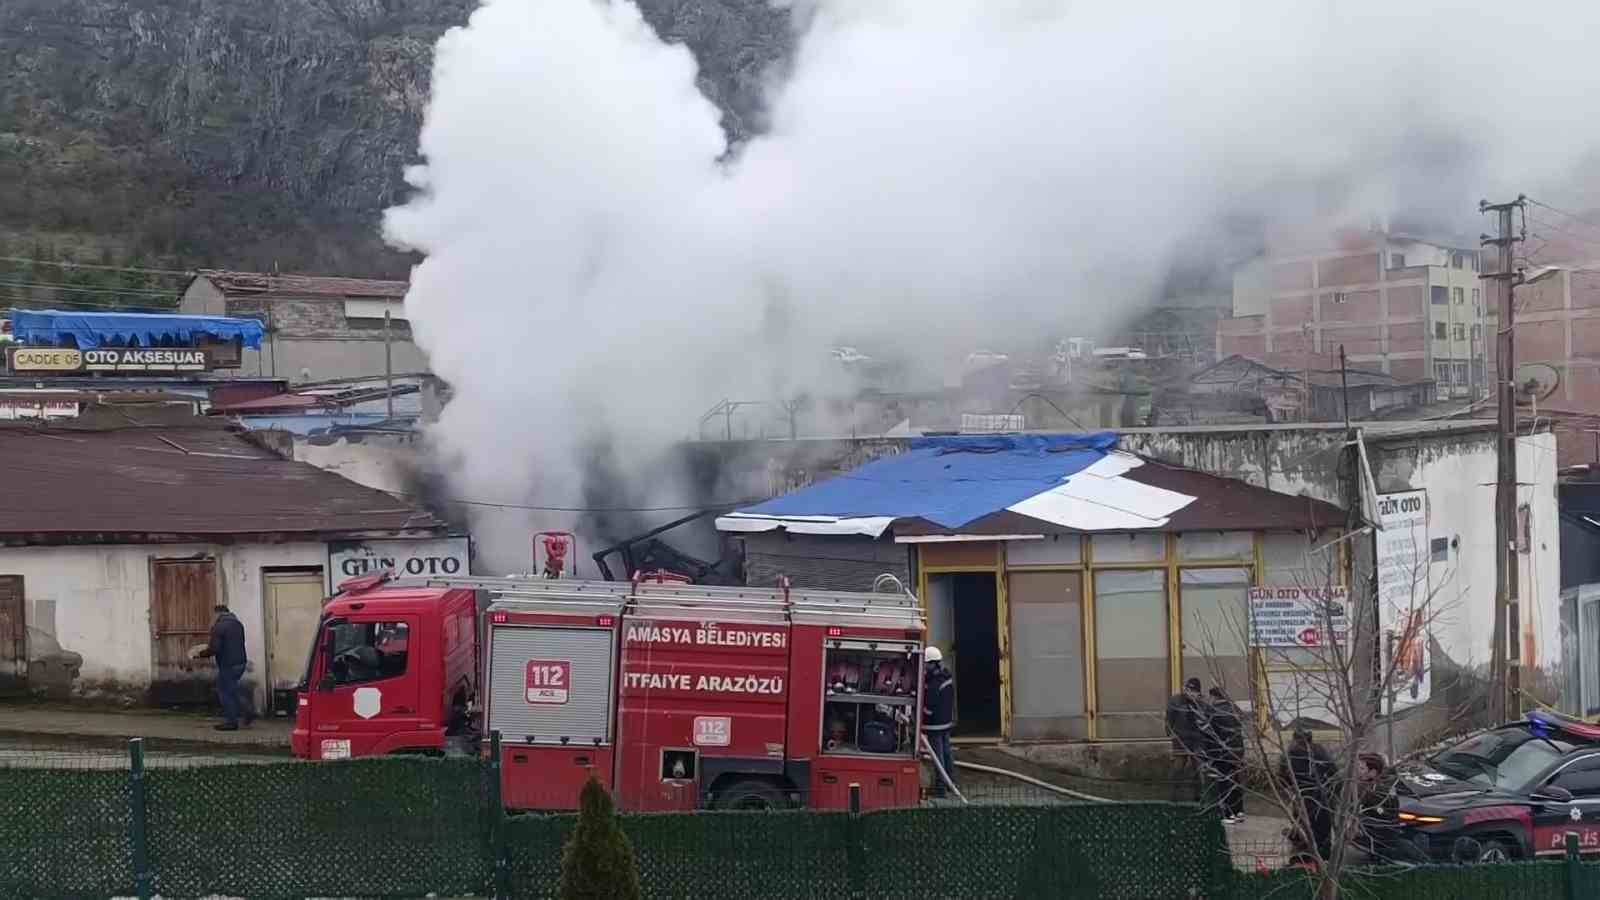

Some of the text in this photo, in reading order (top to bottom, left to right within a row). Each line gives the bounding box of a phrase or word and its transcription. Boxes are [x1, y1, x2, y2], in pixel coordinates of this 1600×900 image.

[17, 353, 80, 365] CADDE 05
[85, 351, 204, 364] OTO AKSESUAR
[1401, 497, 1421, 512] OTO
[405, 557, 460, 575] OTO
[1277, 589, 1300, 599] OTO
[627, 627, 692, 643] AMASYA
[532, 666, 563, 685] 112
[696, 674, 783, 694] ARAZÖZÜ
[699, 721, 725, 734] 112
